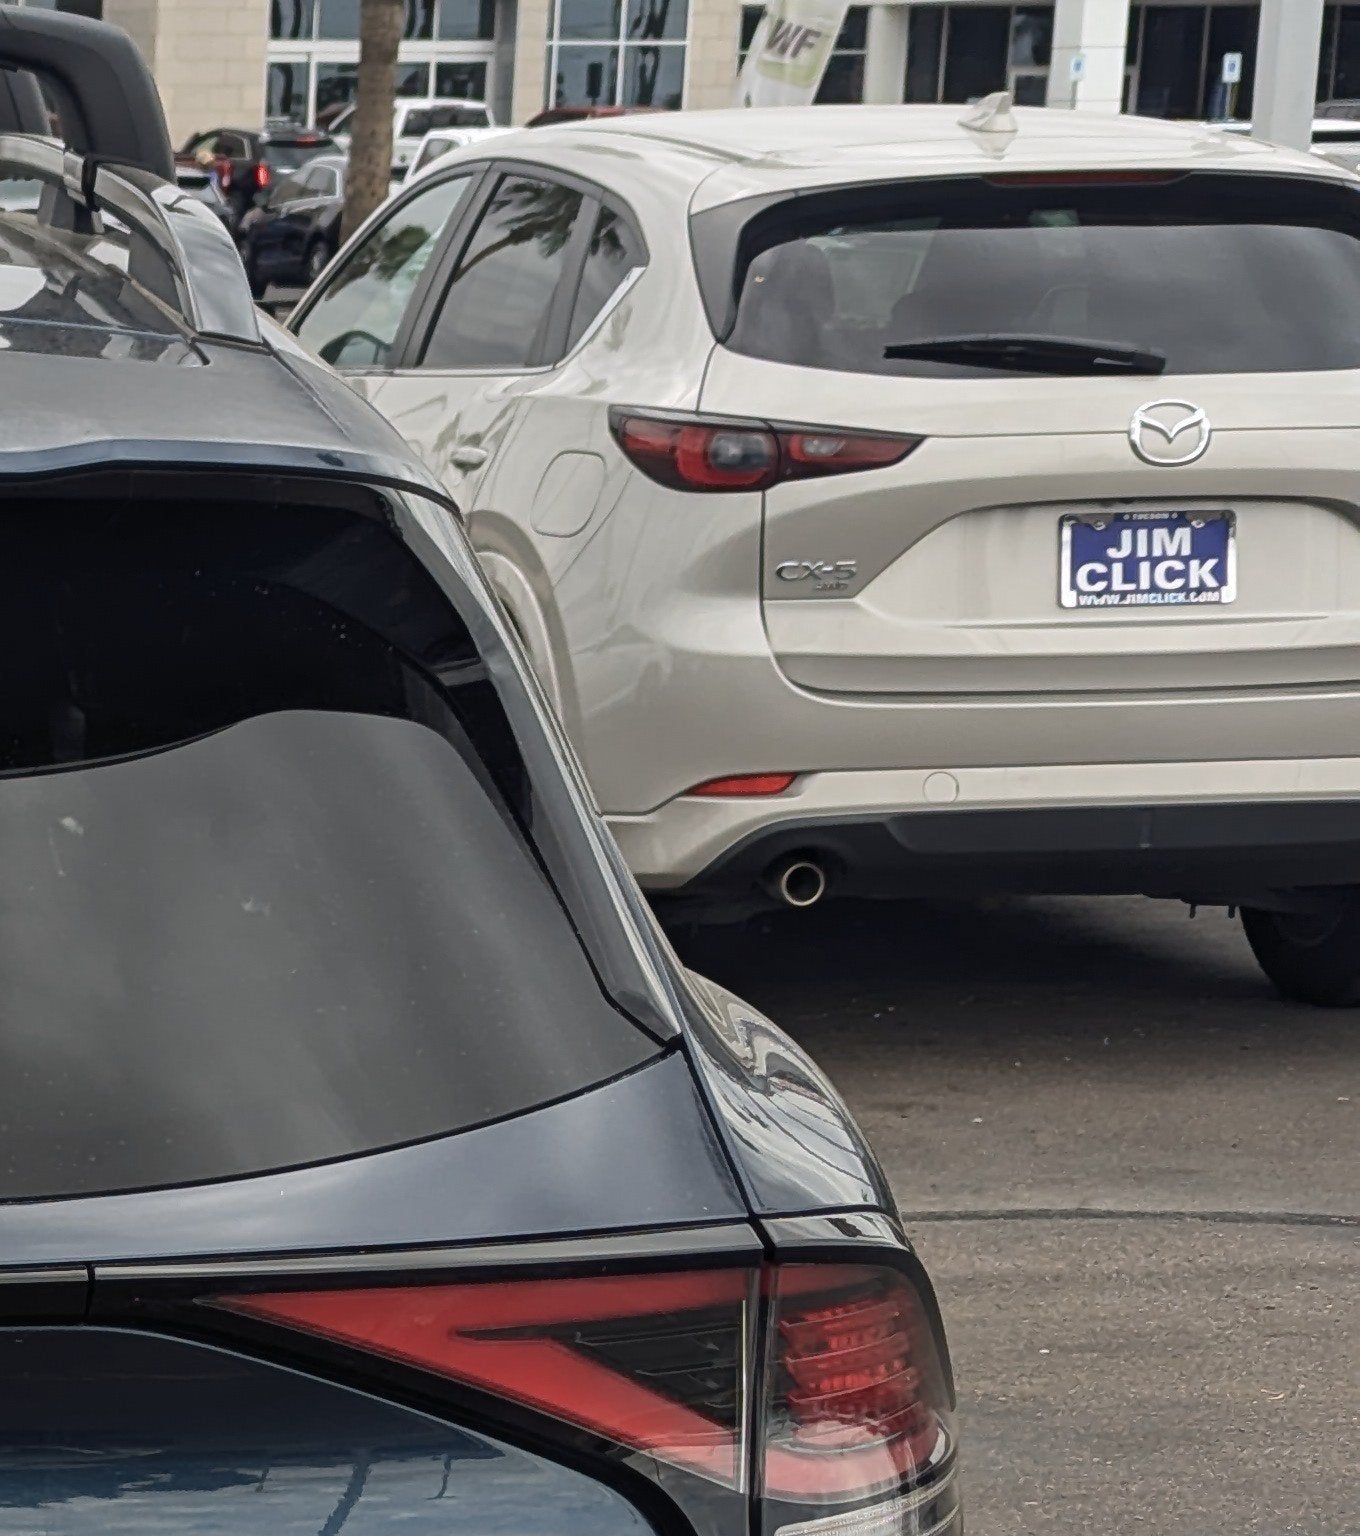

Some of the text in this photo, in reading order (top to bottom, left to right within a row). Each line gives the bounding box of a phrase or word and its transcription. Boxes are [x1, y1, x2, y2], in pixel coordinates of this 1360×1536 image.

[765, 19, 822, 59] WF
[1106, 527, 1192, 559] JIM
[775, 560, 857, 581] CX-5
[1076, 558, 1220, 592] CLICK
